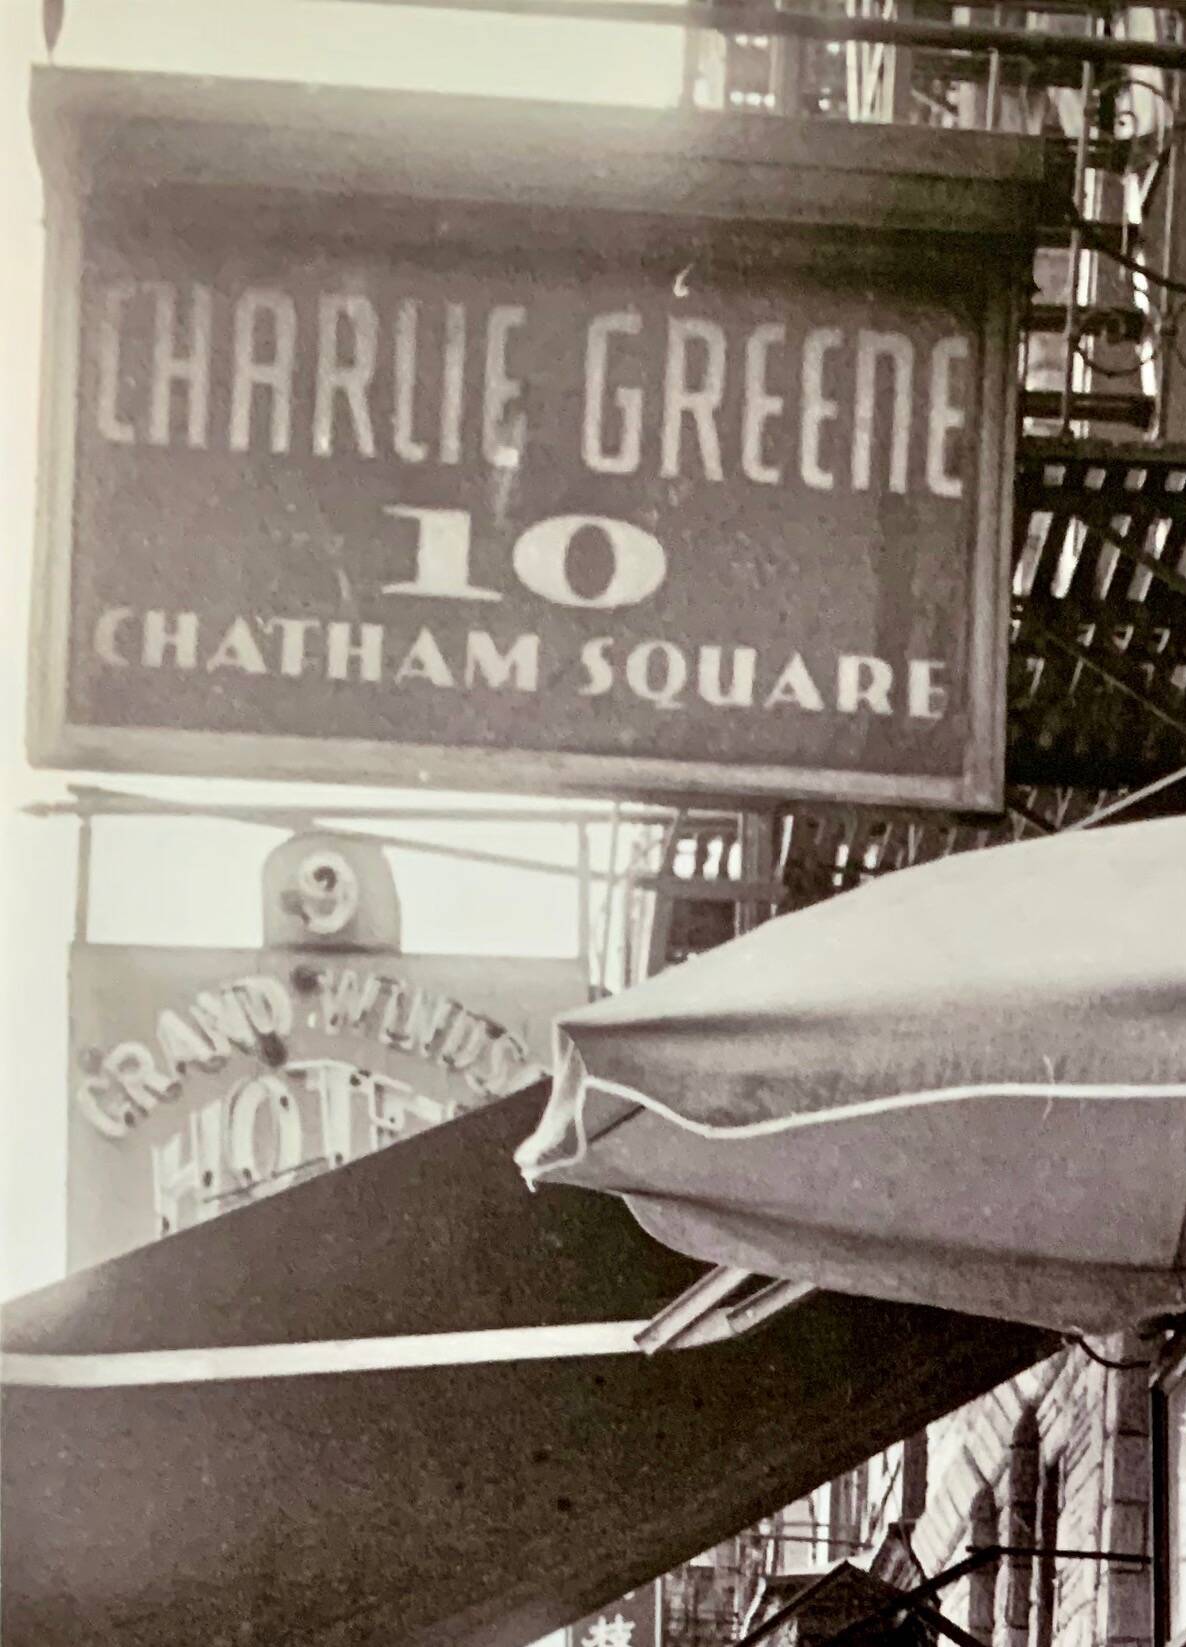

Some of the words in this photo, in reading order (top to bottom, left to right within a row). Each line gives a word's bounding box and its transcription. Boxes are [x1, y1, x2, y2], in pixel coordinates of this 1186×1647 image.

[96, 280, 527, 466] CHARLIE
[580, 311, 971, 498] GREENE
[382, 504, 668, 610] 10
[93, 606, 540, 692] CHATHAM
[580, 635, 950, 721] SQUARE
[300, 850, 358, 935] 9
[76, 975, 293, 1138] GRAND
[317, 969, 553, 1100] WINDS
[152, 1058, 457, 1236] HOTE
